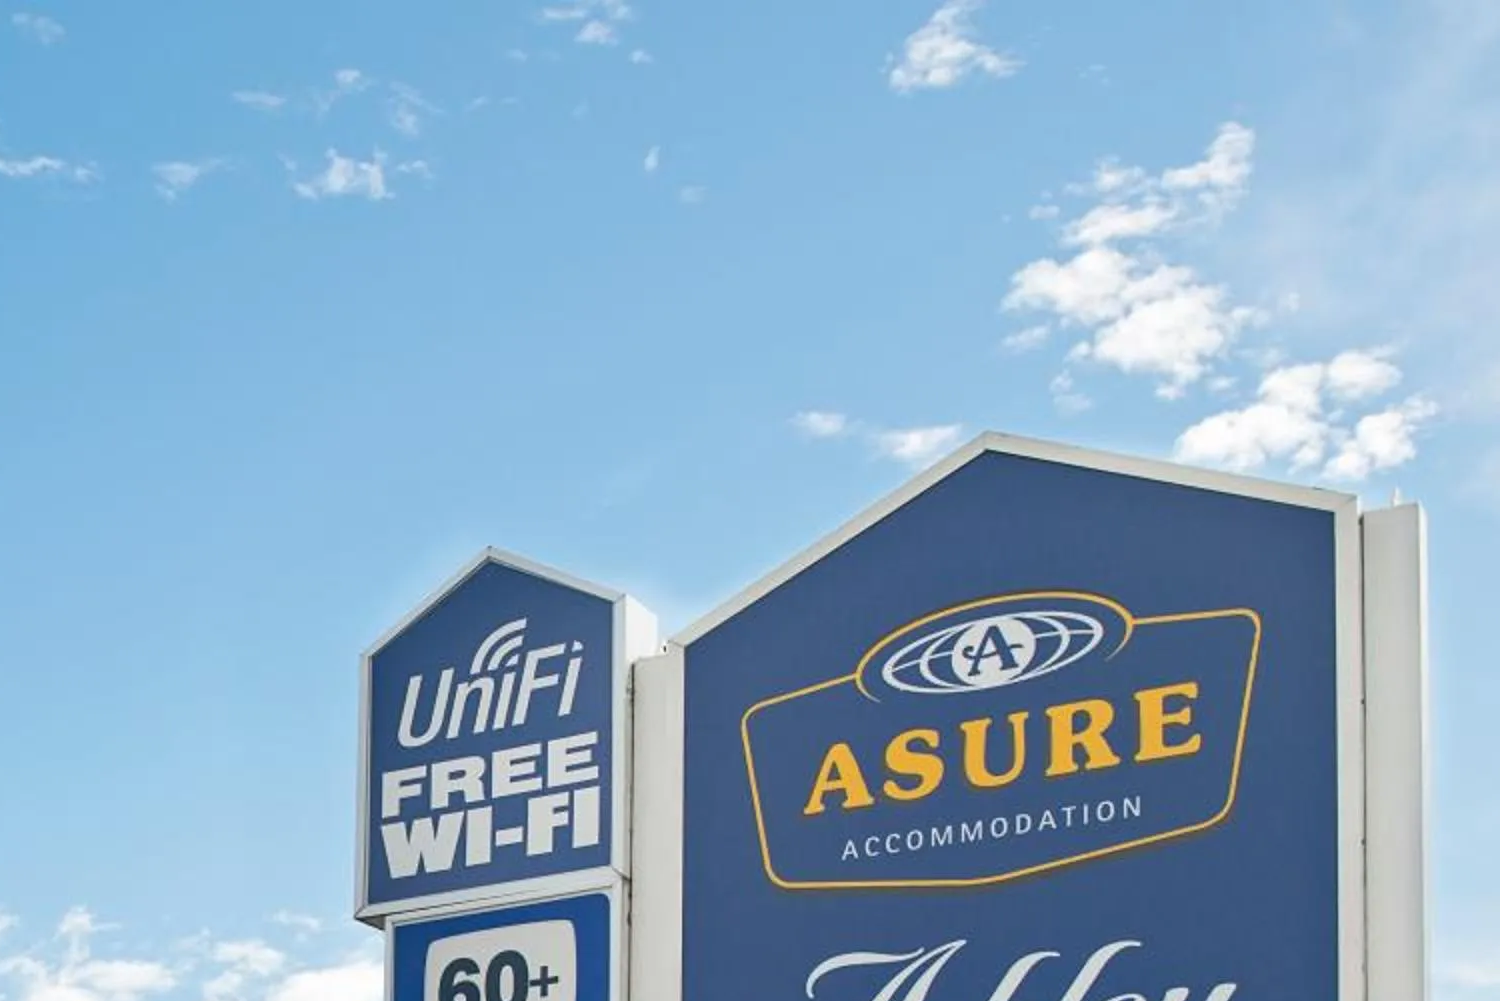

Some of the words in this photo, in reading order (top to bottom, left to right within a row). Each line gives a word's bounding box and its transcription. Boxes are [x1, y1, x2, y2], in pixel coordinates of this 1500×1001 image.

[397, 638, 584, 748] UniFi
[381, 731, 599, 819] FREE
[804, 681, 1202, 815] ASURE
[381, 786, 600, 879] WI-FI
[840, 795, 1143, 861] ACCOMMODATION
